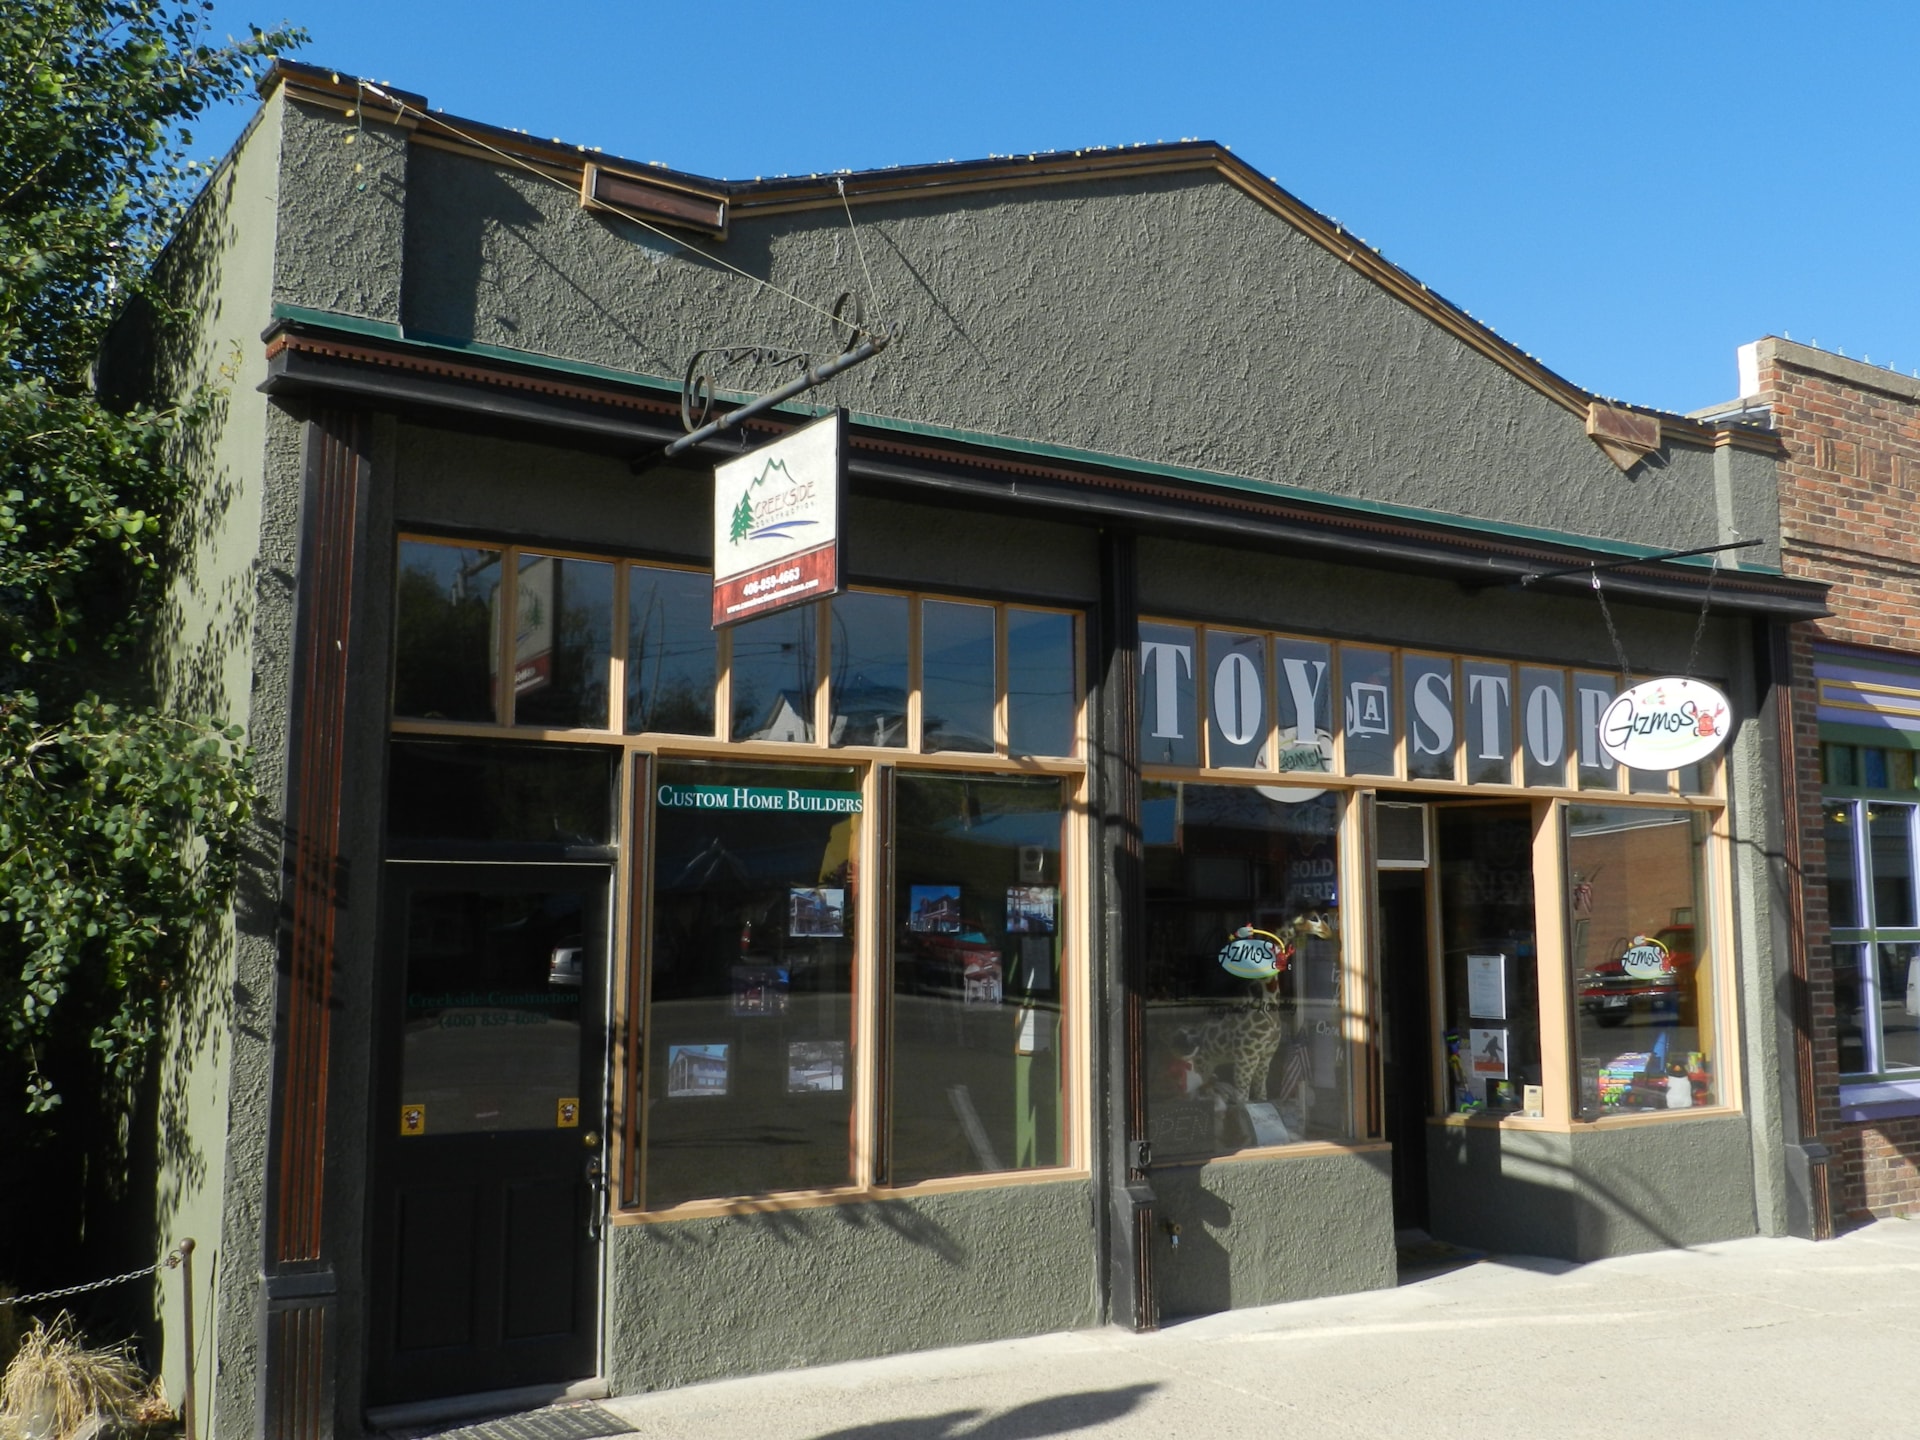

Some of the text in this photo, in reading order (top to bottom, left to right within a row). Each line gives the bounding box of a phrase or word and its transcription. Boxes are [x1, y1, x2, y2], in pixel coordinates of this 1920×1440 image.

[755, 481, 816, 520] CREEKSIDE
[743, 567, 800, 597] 406-859-4663
[1141, 641, 1327, 745] TOY
[1413, 672, 1614, 770] STOR
[657, 785, 864, 813] CUSTOM HOME BUILDERS
[1292, 859, 1334, 878] SOLD
[408, 991, 579, 1008] Creekside Construction
